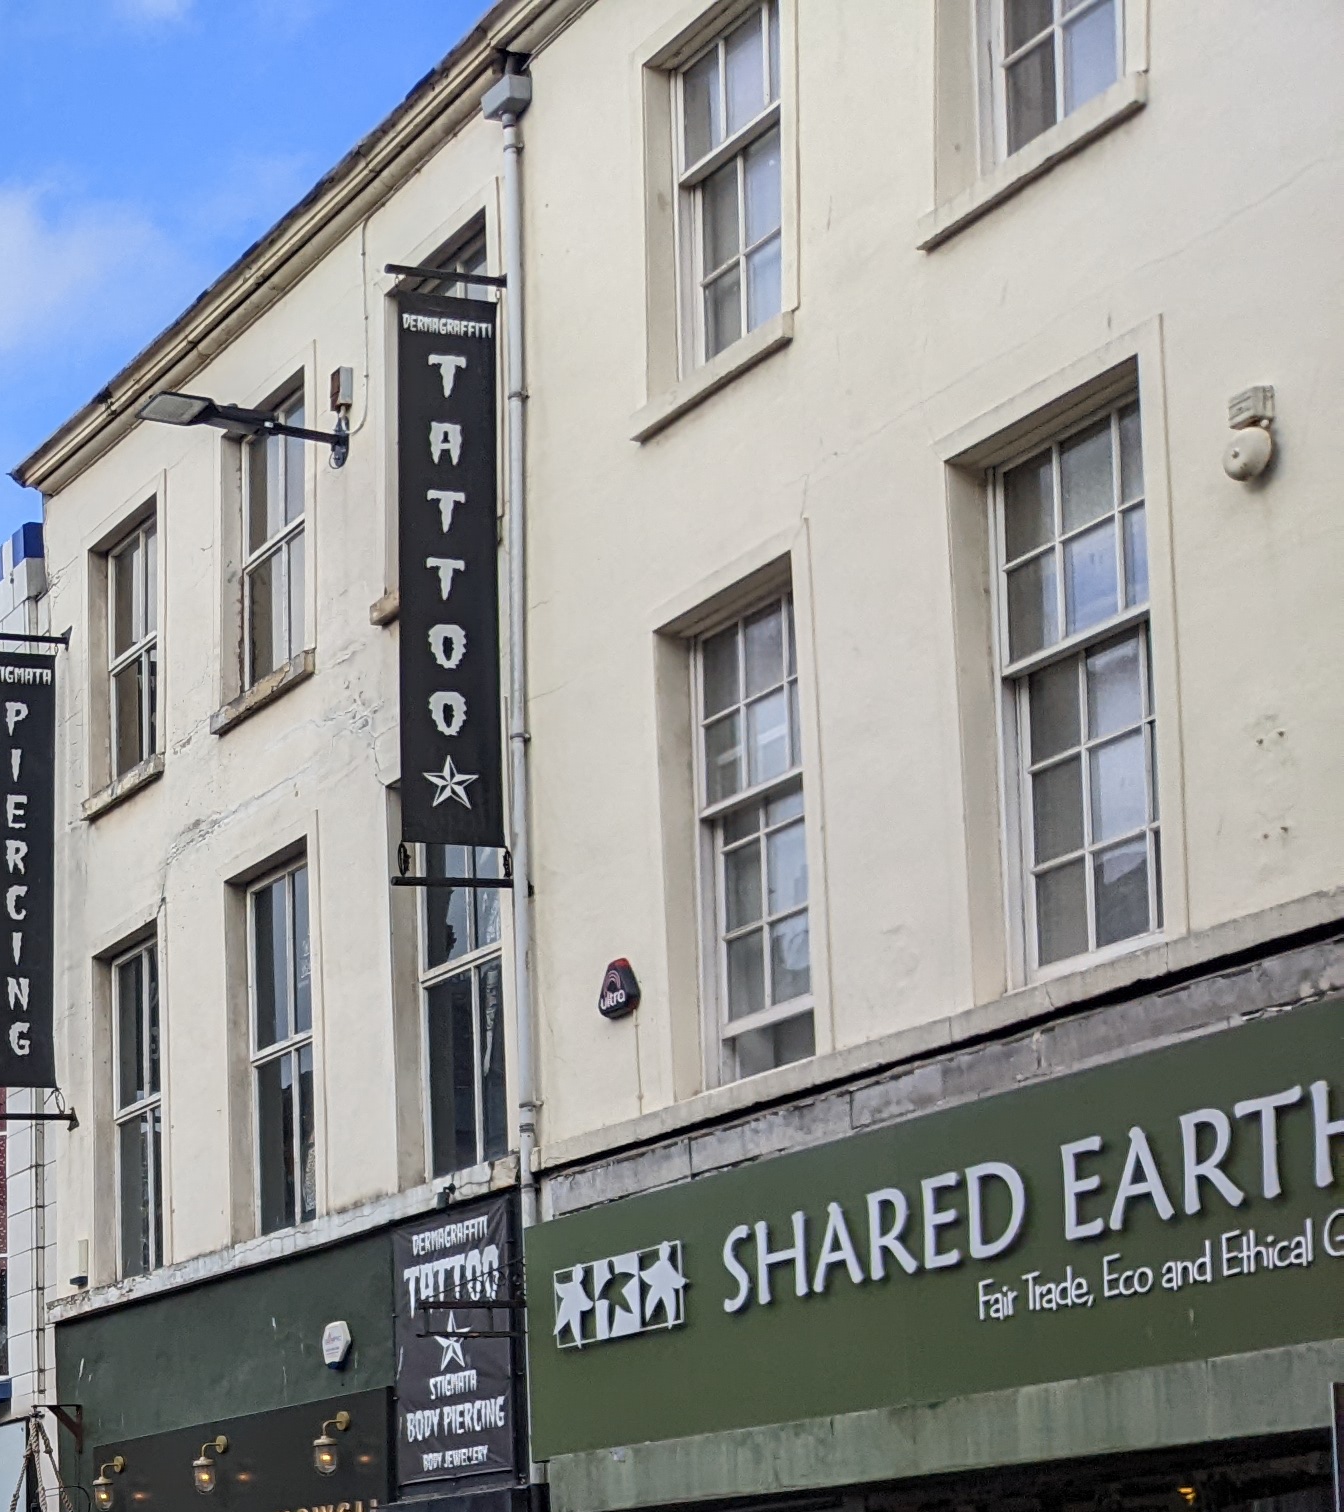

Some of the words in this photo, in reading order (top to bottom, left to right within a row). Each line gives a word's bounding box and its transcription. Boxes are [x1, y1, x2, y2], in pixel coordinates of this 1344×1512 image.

[401, 312, 493, 339] DERMAGRAFFITI
[425, 353, 468, 737] TATTOO
[5, 700, 31, 1057] PIERCING
[412, 1214, 489, 1256] DERMAGRAFFITI
[723, 1161, 1027, 1314] SHARED
[403, 1244, 500, 1319] TATTOO
[977, 1278, 1018, 1322] Fair
[1022, 1268, 1094, 1316] Trade,
[1101, 1254, 1153, 1298] Eco
[1161, 1241, 1213, 1292] and
[1220, 1216, 1314, 1278] Ethical
[429, 1369, 477, 1400] STIGMATA
[406, 1407, 441, 1443] BODY
[442, 1395, 505, 1437] PIERCING
[423, 1452, 443, 1472] BODY
[443, 1445, 489, 1468] JEWELLERY
